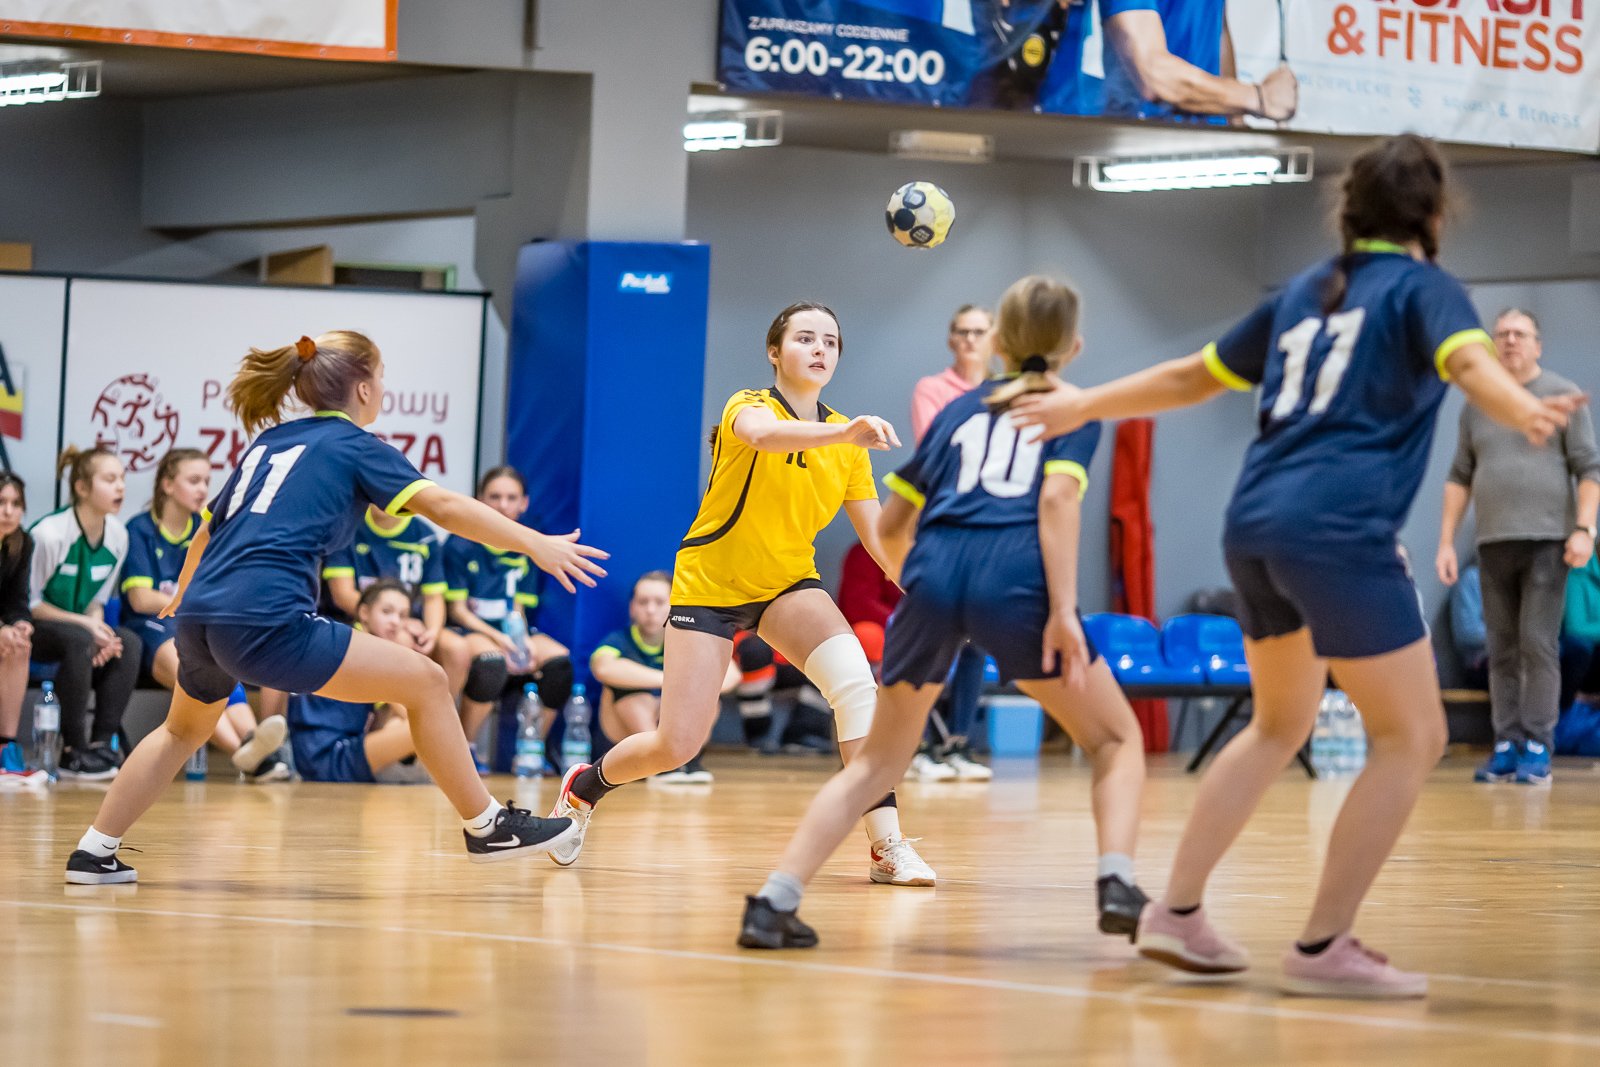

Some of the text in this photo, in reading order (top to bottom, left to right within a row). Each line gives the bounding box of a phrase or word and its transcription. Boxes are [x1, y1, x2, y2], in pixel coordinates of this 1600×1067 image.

[745, 36, 945, 85] 6:00-22:00
[748, 16, 834, 36] ZAPRASZAMY
[1327, 4, 1584, 74] & FITNESS
[1270, 306, 1366, 420] 11
[225, 444, 307, 520] 11
[951, 411, 1045, 498] 10
